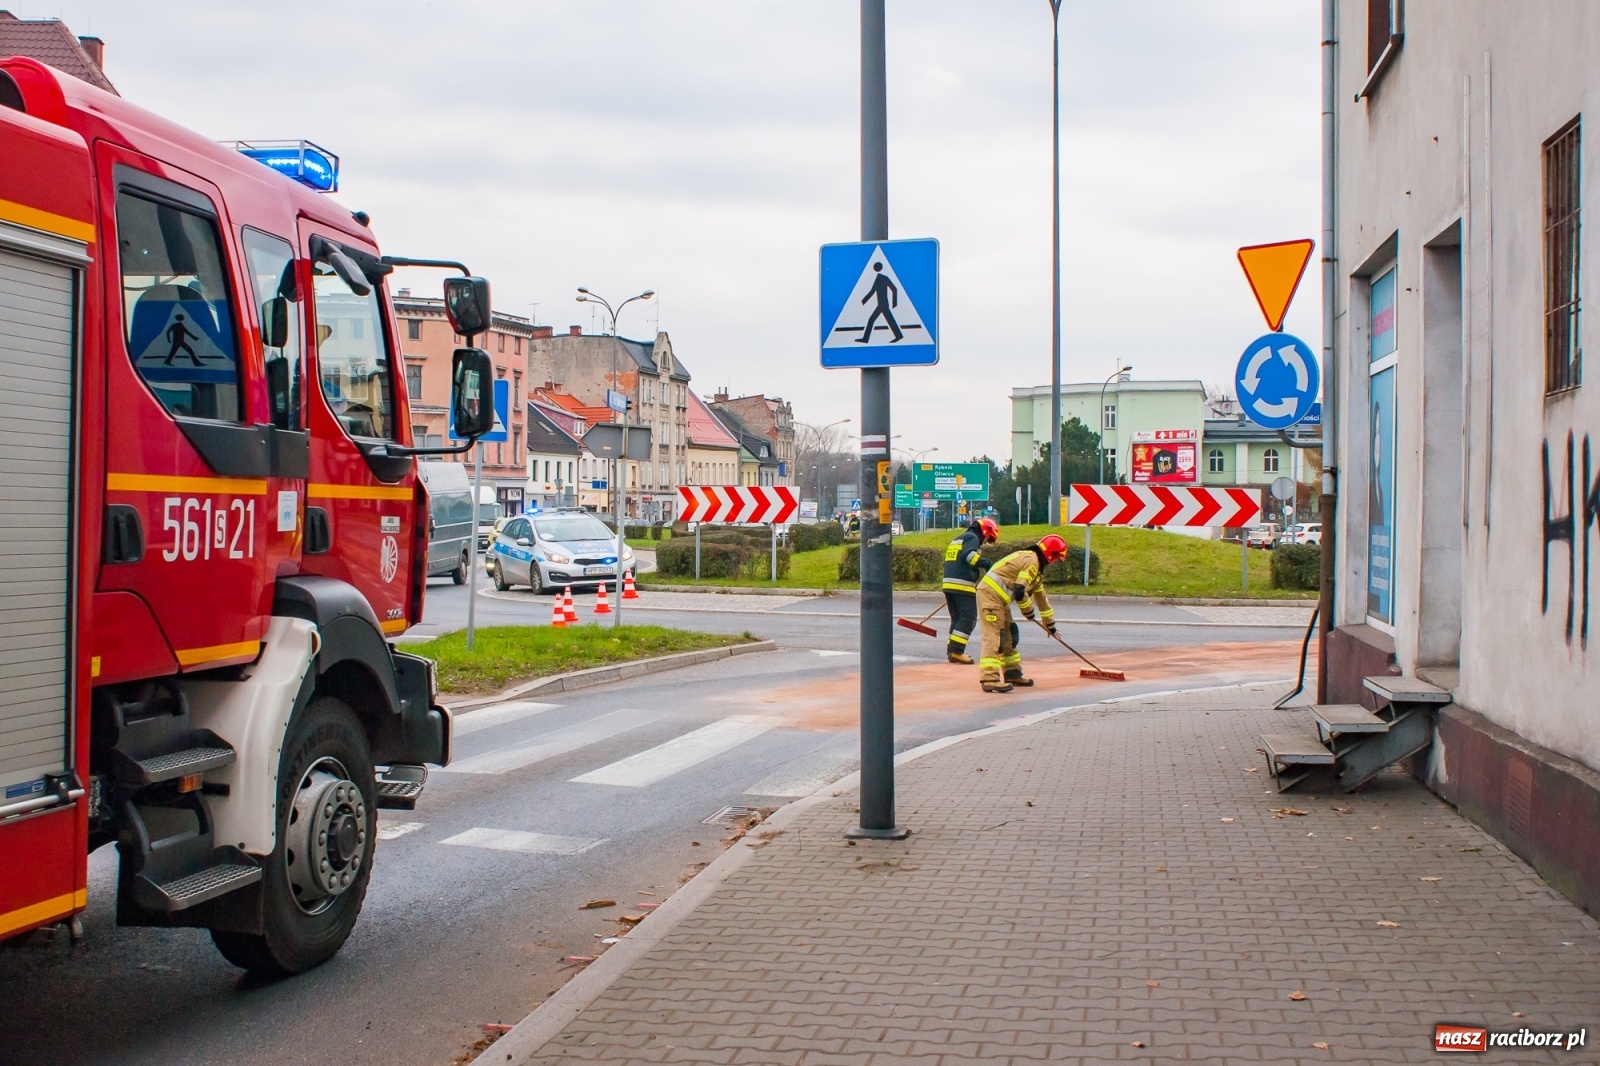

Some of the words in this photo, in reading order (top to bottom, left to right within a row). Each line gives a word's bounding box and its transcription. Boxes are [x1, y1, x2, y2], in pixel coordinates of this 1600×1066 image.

[1176, 430, 1188, 438] min
[162, 497, 211, 562] 561
[229, 498, 254, 559] 21
